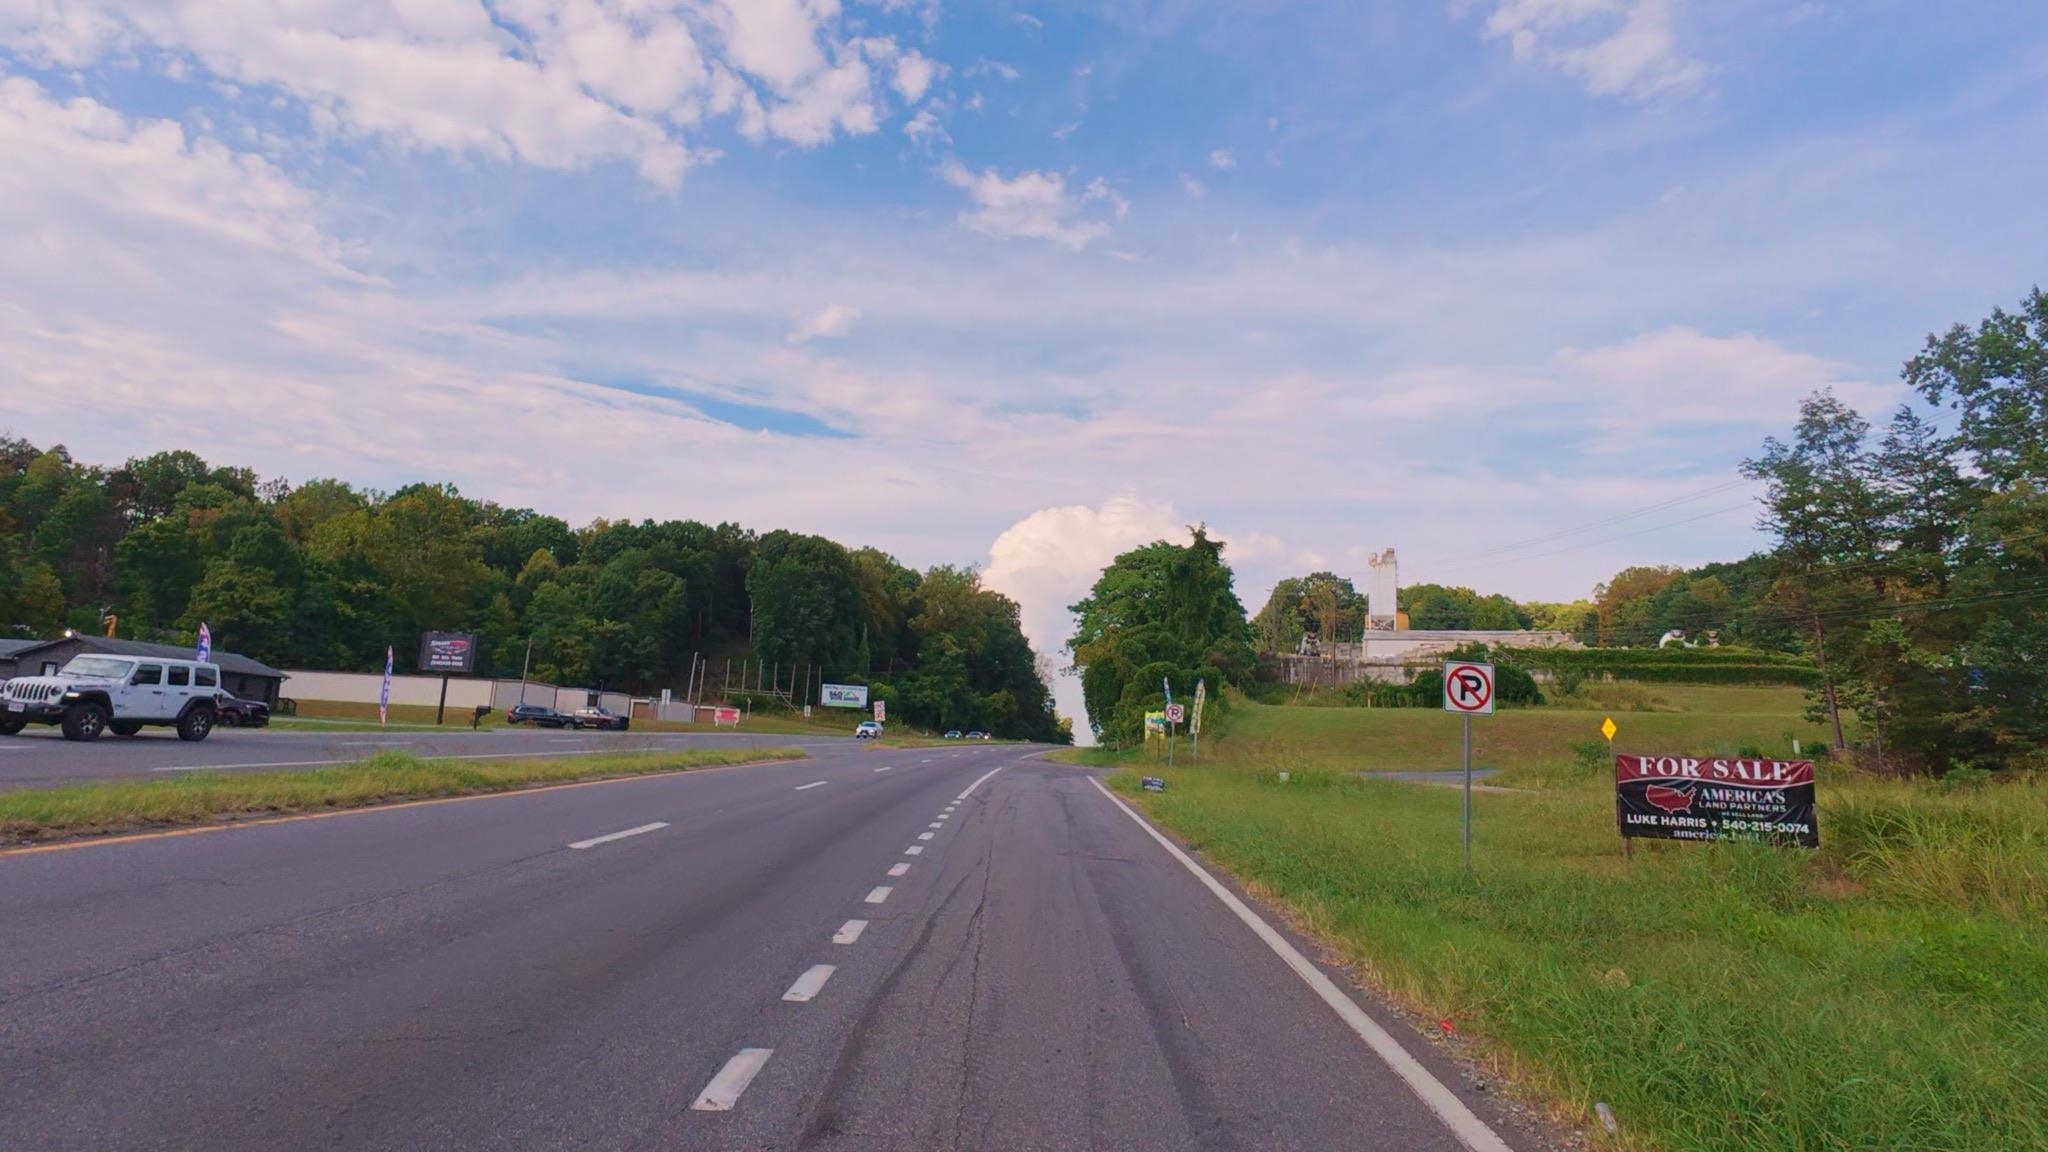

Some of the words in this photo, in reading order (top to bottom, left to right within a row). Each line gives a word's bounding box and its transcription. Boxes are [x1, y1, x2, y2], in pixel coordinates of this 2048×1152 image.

[1640, 756, 1701, 777] FOR
[1713, 759, 1792, 781] SALE
[1700, 787, 1786, 804] AMERICA'S
[1698, 801, 1727, 809] LAND
[1729, 802, 1787, 813] PARTNERS
[1627, 813, 1658, 825] LUKE
[1660, 815, 1708, 828] HARRIS
[1721, 819, 1810, 834] 540-215-0074
